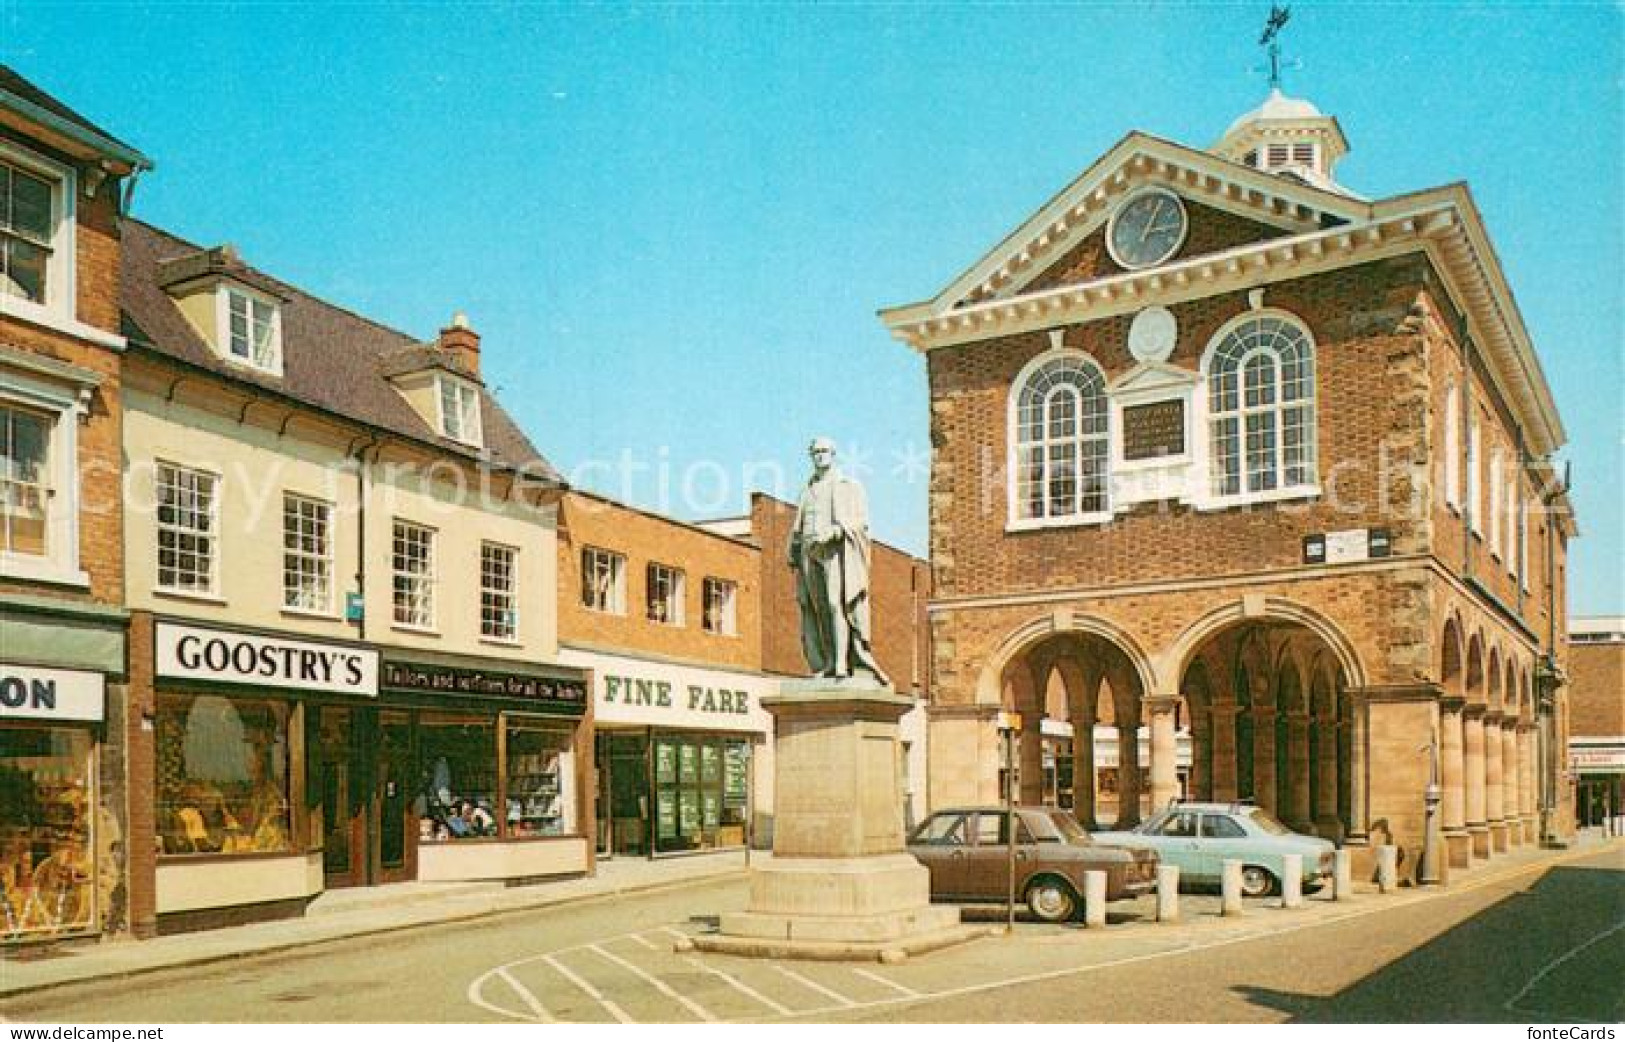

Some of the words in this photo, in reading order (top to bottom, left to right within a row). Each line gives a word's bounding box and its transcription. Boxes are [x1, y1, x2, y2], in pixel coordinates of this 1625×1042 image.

[177, 635, 363, 686] GOOSTRY'S
[603, 675, 671, 707] FINE
[687, 685, 748, 714] FARE
